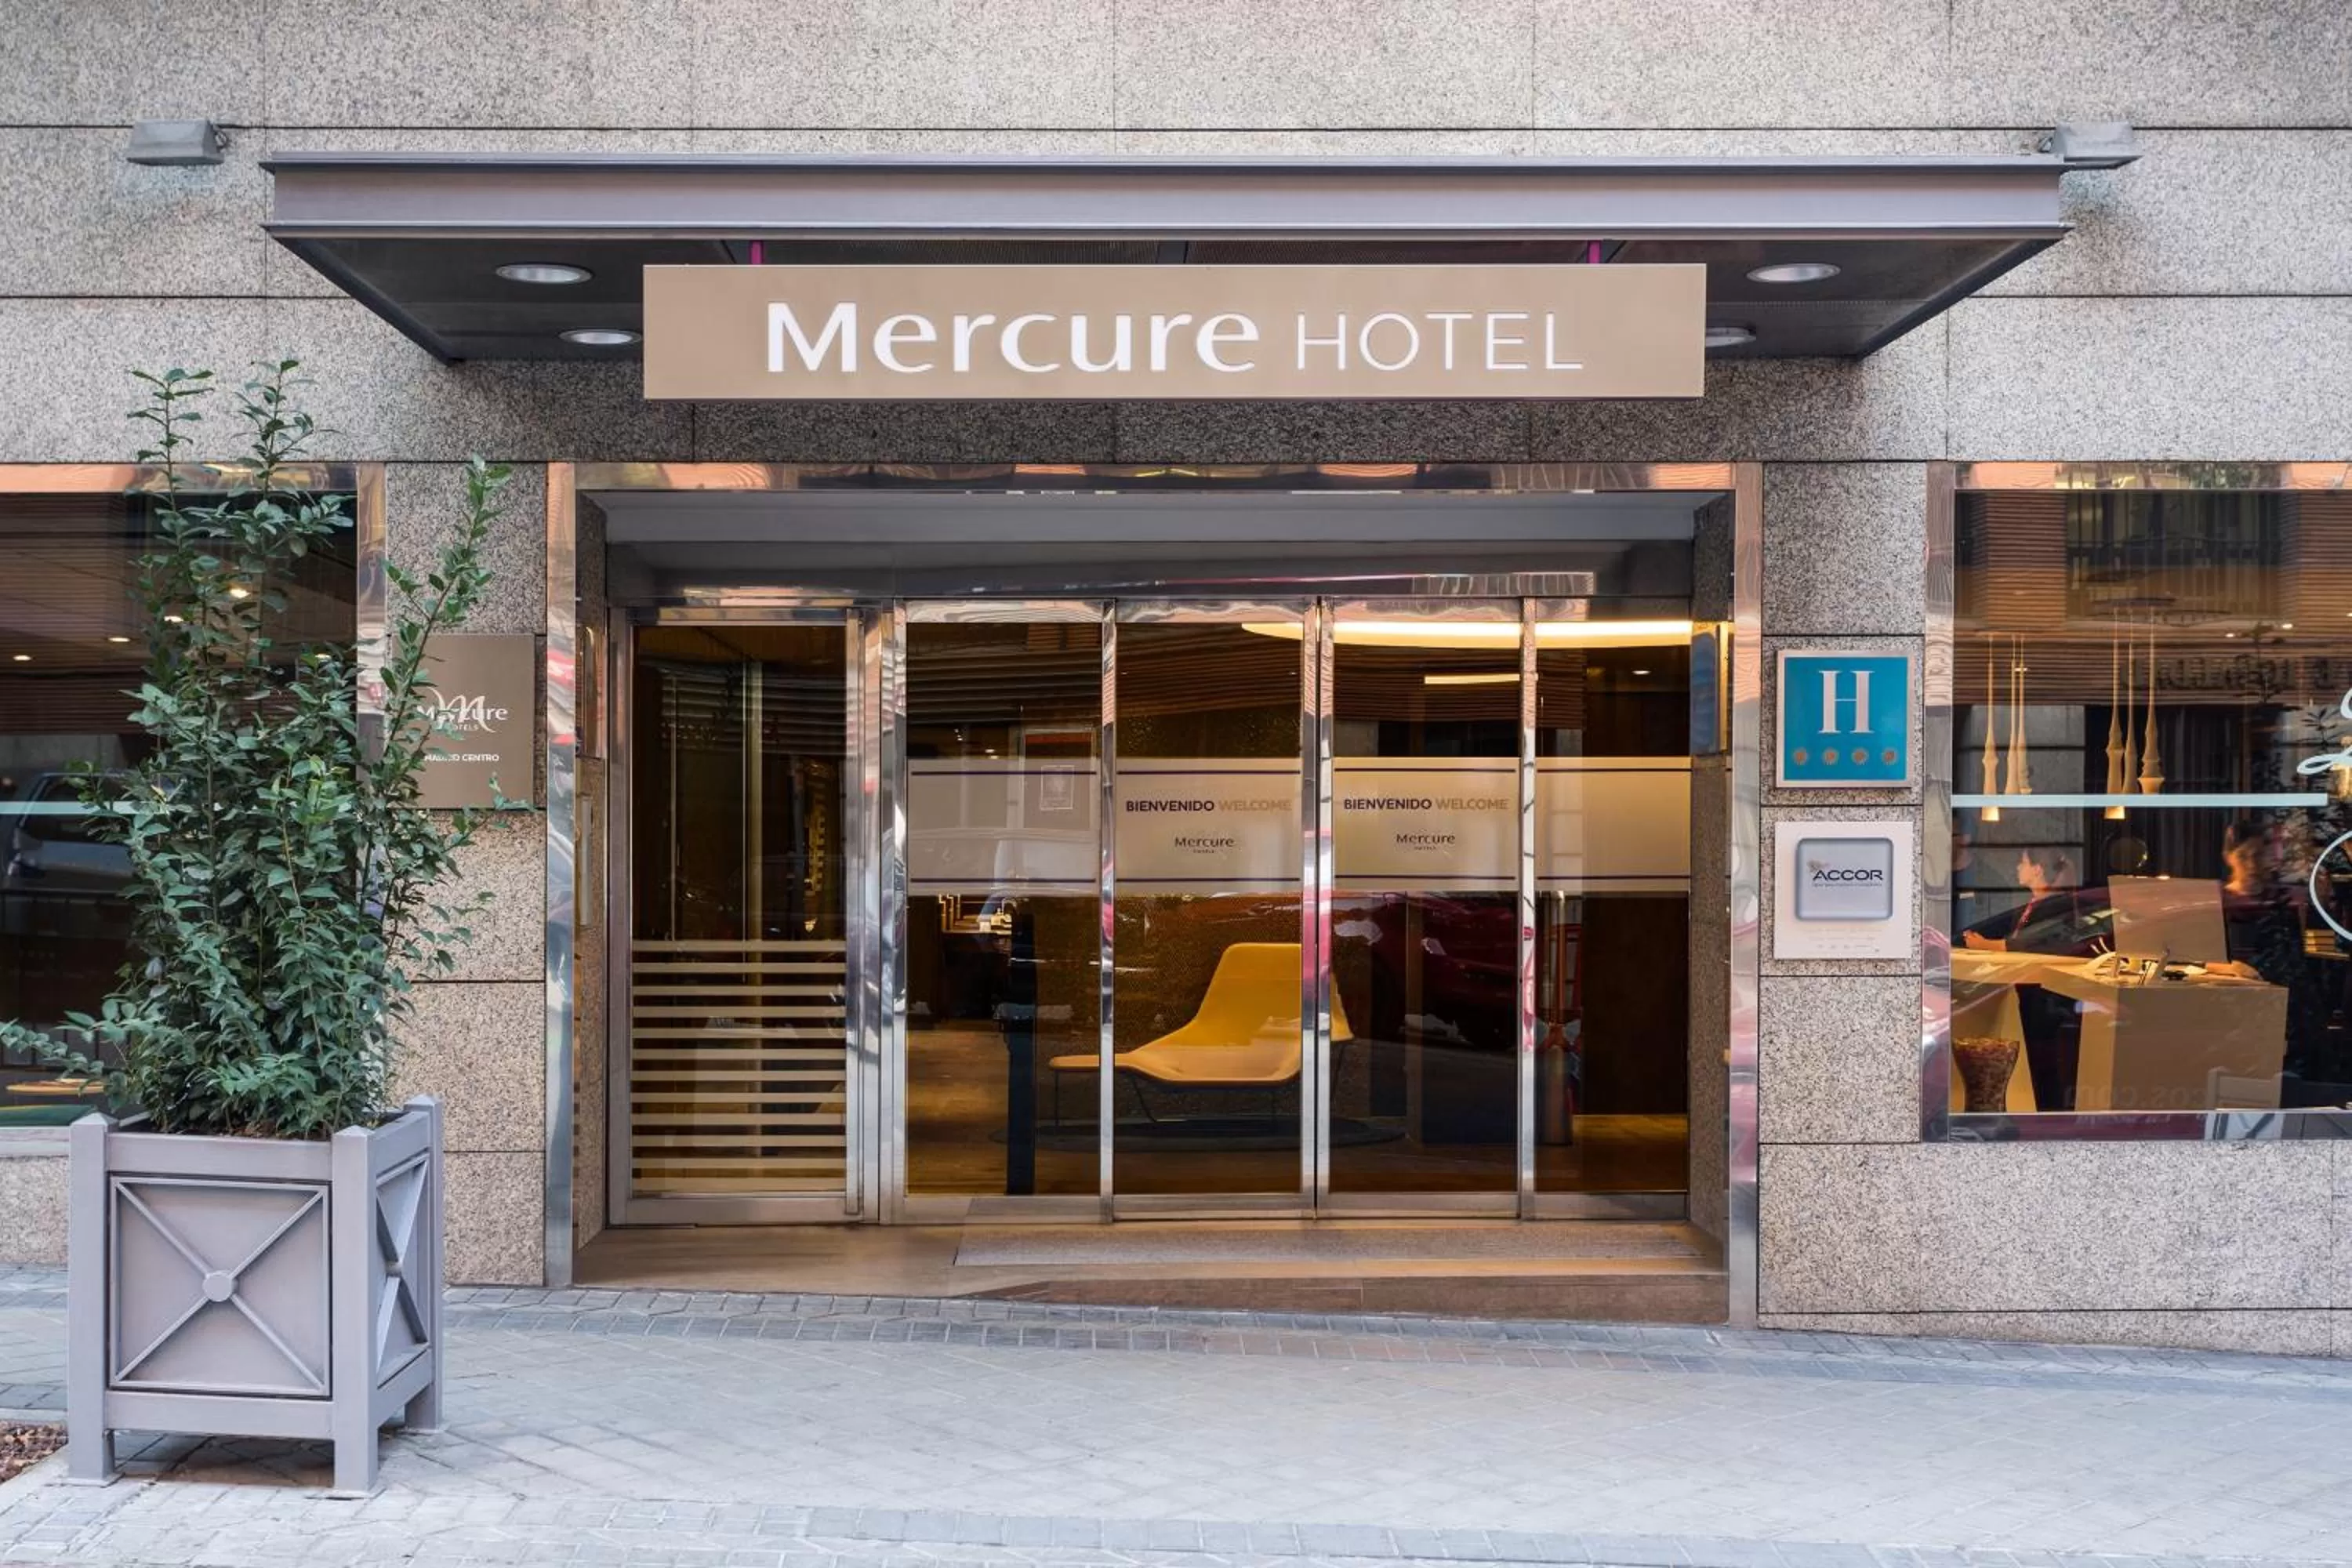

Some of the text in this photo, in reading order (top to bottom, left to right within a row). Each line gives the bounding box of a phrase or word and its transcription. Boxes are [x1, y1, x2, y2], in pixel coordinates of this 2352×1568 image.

[768, 301, 1584, 373] Mercure HOTEL
[1818, 670, 1875, 734] H
[462, 753, 500, 762] CENTRO
[1126, 800, 1292, 812] BIENVENIDO WELCOME
[1344, 798, 1508, 810] BIENVENIDO WELCOME
[1174, 837, 1236, 848] Mercure
[1396, 833, 1456, 844] Mercure
[1813, 869, 1883, 881] ACCOR
